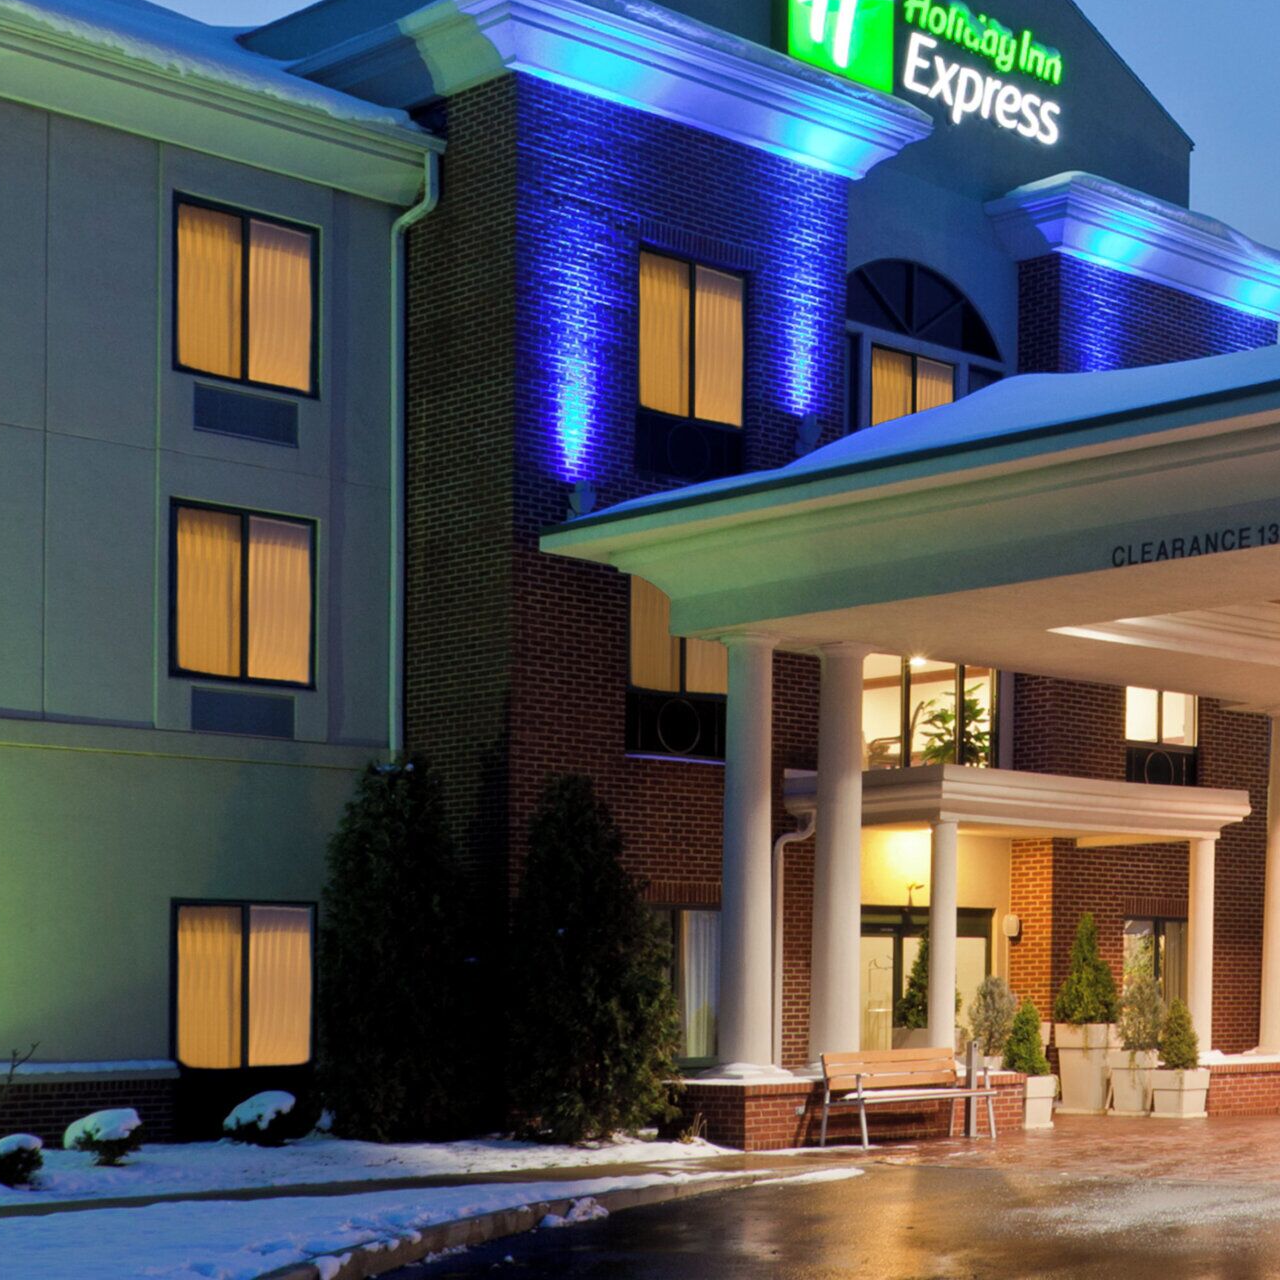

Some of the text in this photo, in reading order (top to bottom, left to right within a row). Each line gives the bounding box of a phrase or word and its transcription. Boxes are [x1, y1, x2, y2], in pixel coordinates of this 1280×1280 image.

[1019, 30, 1063, 85] Inn
[903, 31, 1062, 146] Express
[1111, 523, 1280, 568] CLEARANCE 13
